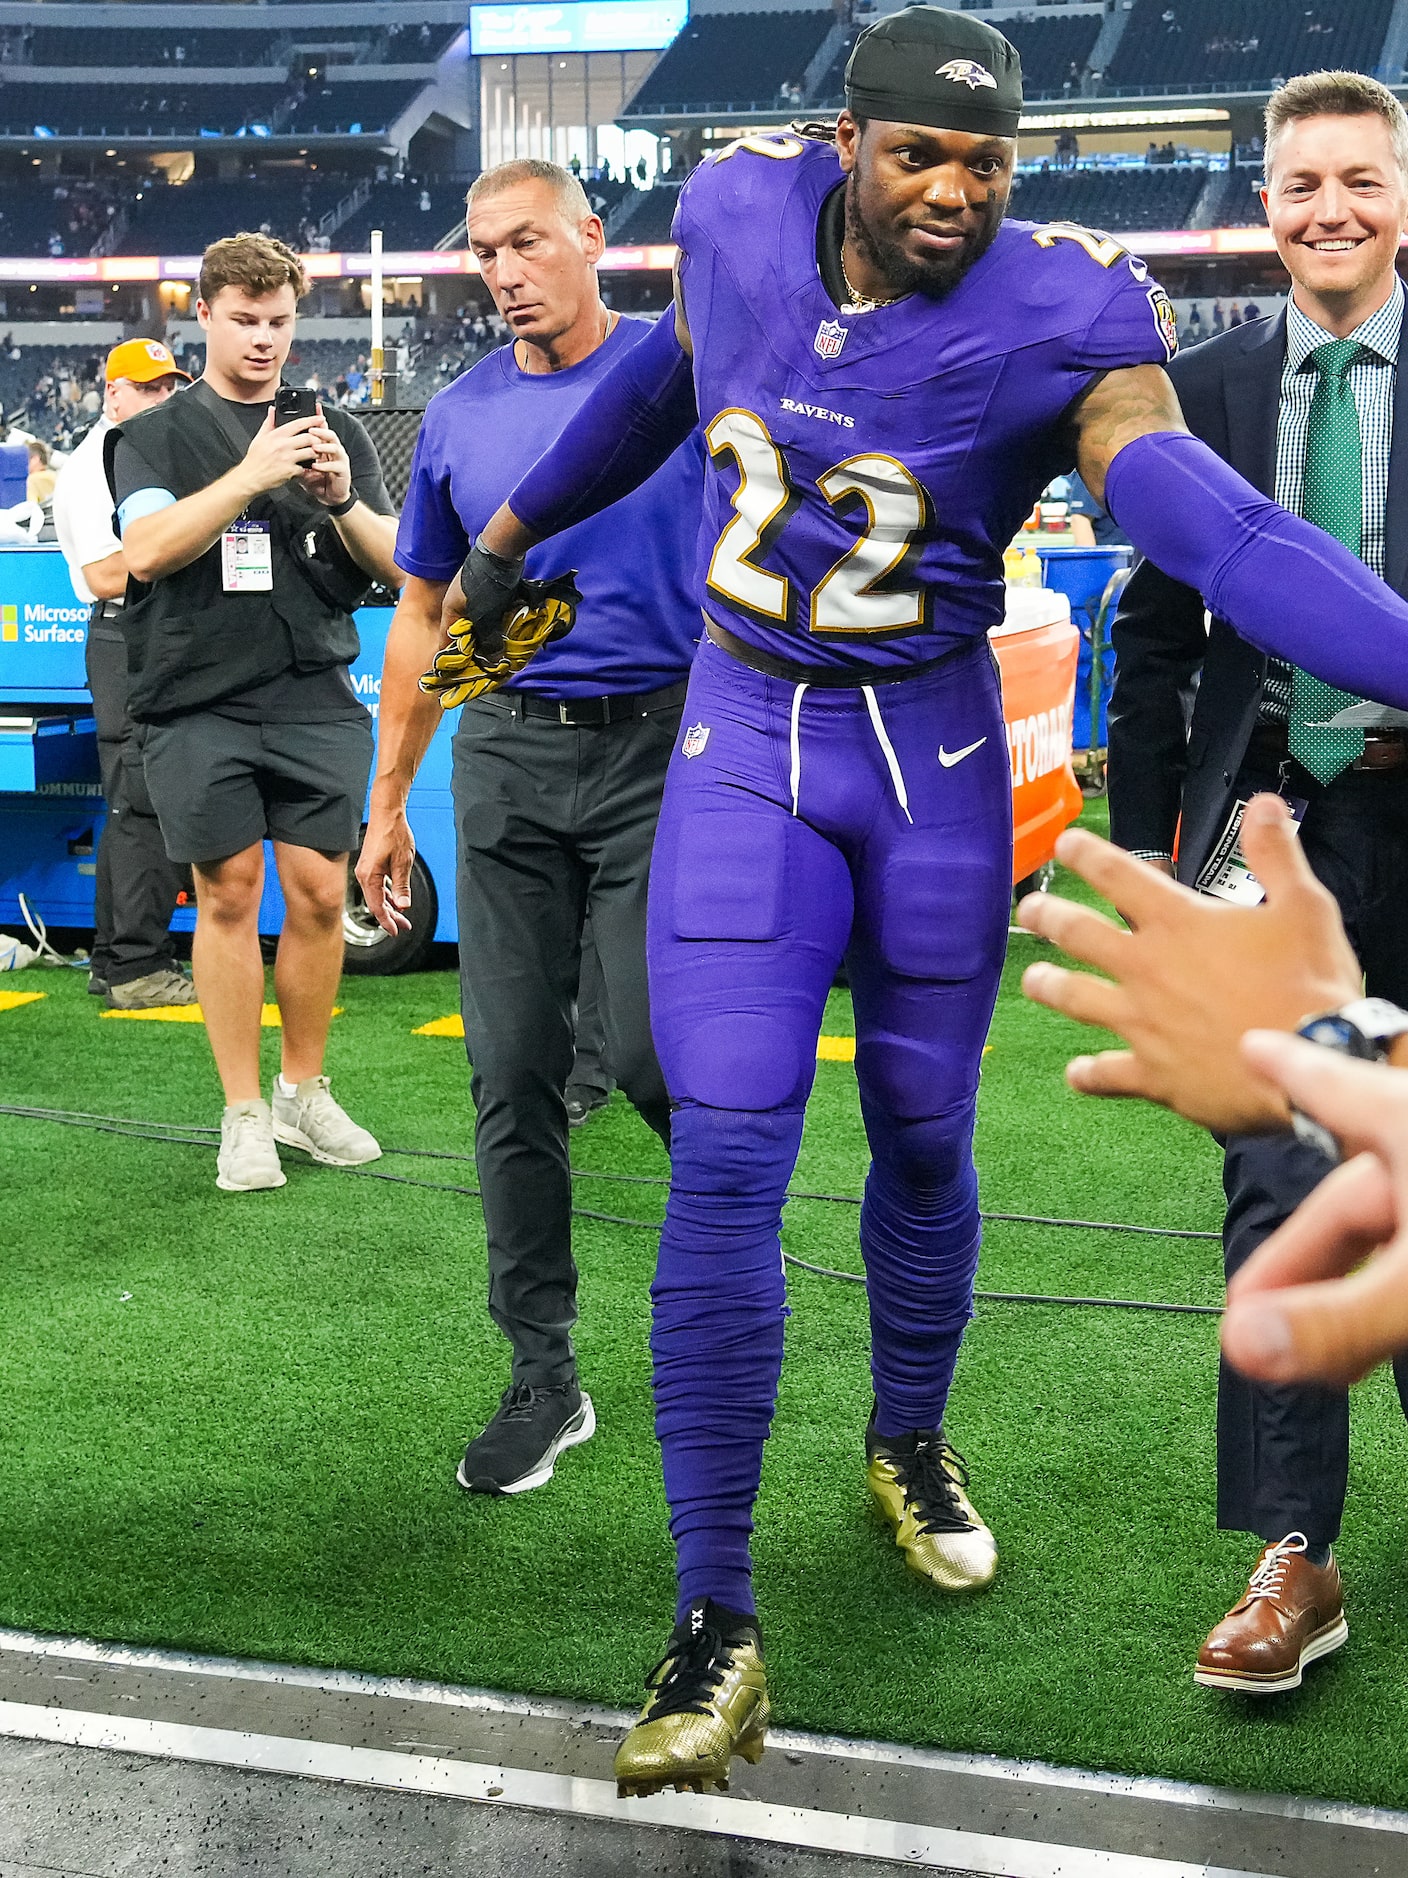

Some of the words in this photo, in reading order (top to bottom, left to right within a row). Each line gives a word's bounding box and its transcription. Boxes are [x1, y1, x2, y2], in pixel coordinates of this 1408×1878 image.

[819, 335, 838, 353] NFL
[780, 398, 855, 428] RAVENS
[704, 406, 930, 637] 22
[24, 624, 84, 642] Surface
[1219, 808, 1246, 856] VISITING
[1200, 855, 1224, 887] TEAM
